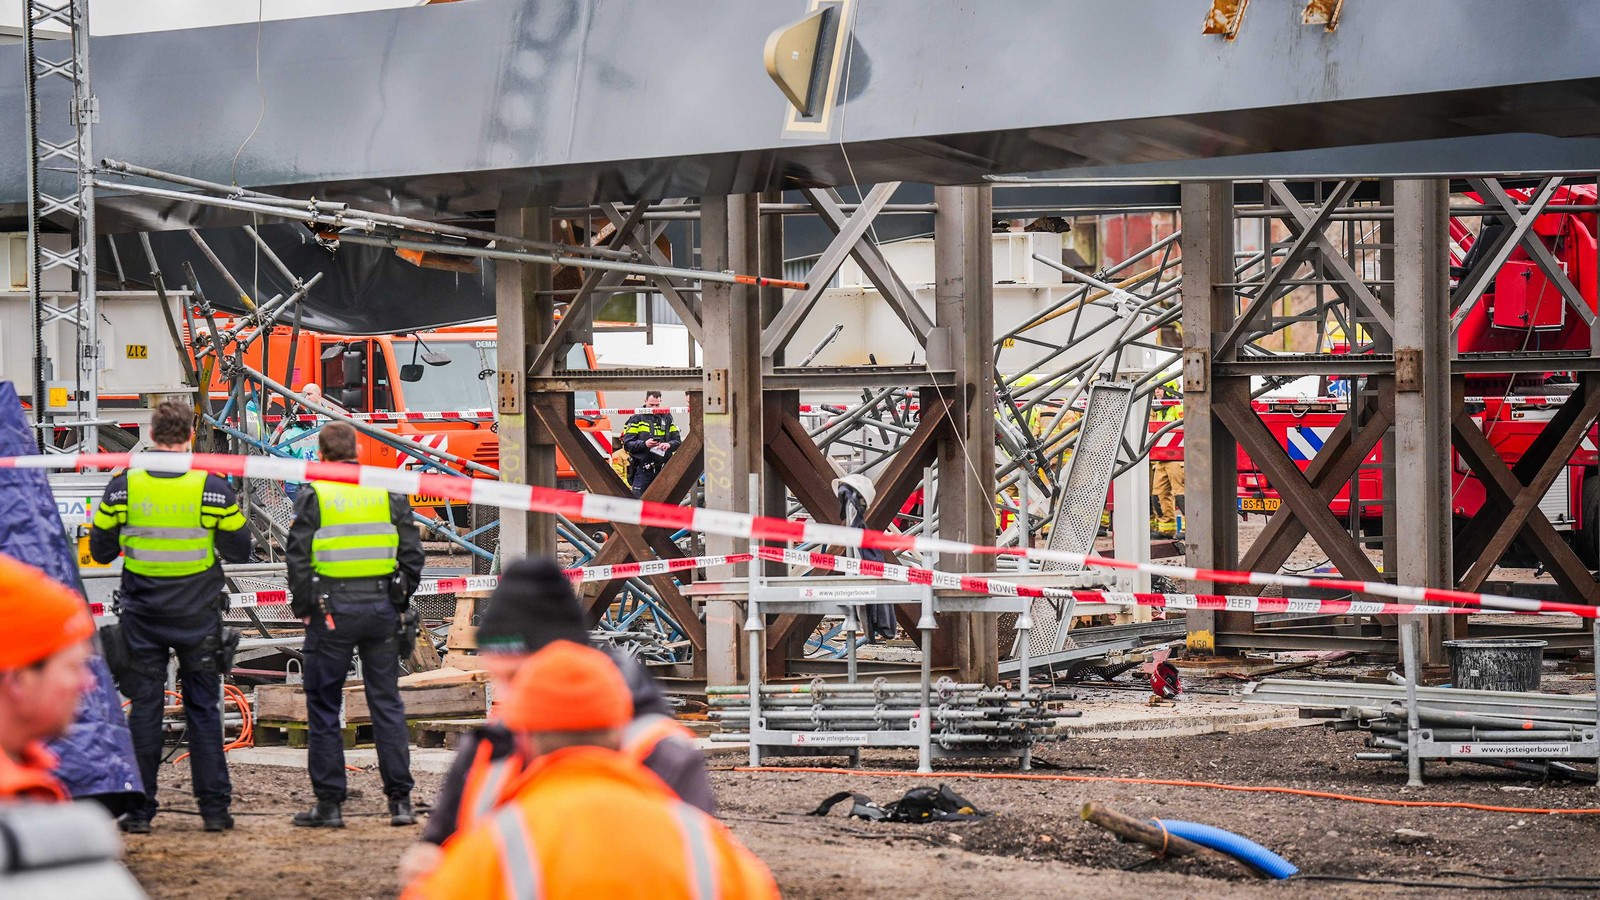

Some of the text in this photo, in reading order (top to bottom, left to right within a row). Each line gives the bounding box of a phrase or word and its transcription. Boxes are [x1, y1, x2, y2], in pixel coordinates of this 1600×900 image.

[475, 340, 498, 348] DEMA
[127, 345, 147, 357] 217
[241, 590, 293, 604] BRANDWE
[417, 581, 453, 593] DWEER
[462, 578, 497, 589] BRAND
[603, 563, 664, 577] BRANDWEER
[785, 552, 839, 568] BRANDWEER
[847, 560, 899, 578] BRANDWEER
[970, 580, 1030, 596] BRANDWEER
[1186, 598, 1252, 609] BRANDWEER
[805, 589, 813, 597] JS
[1459, 745, 1569, 755] JS www.jssteigerbouw.nl
